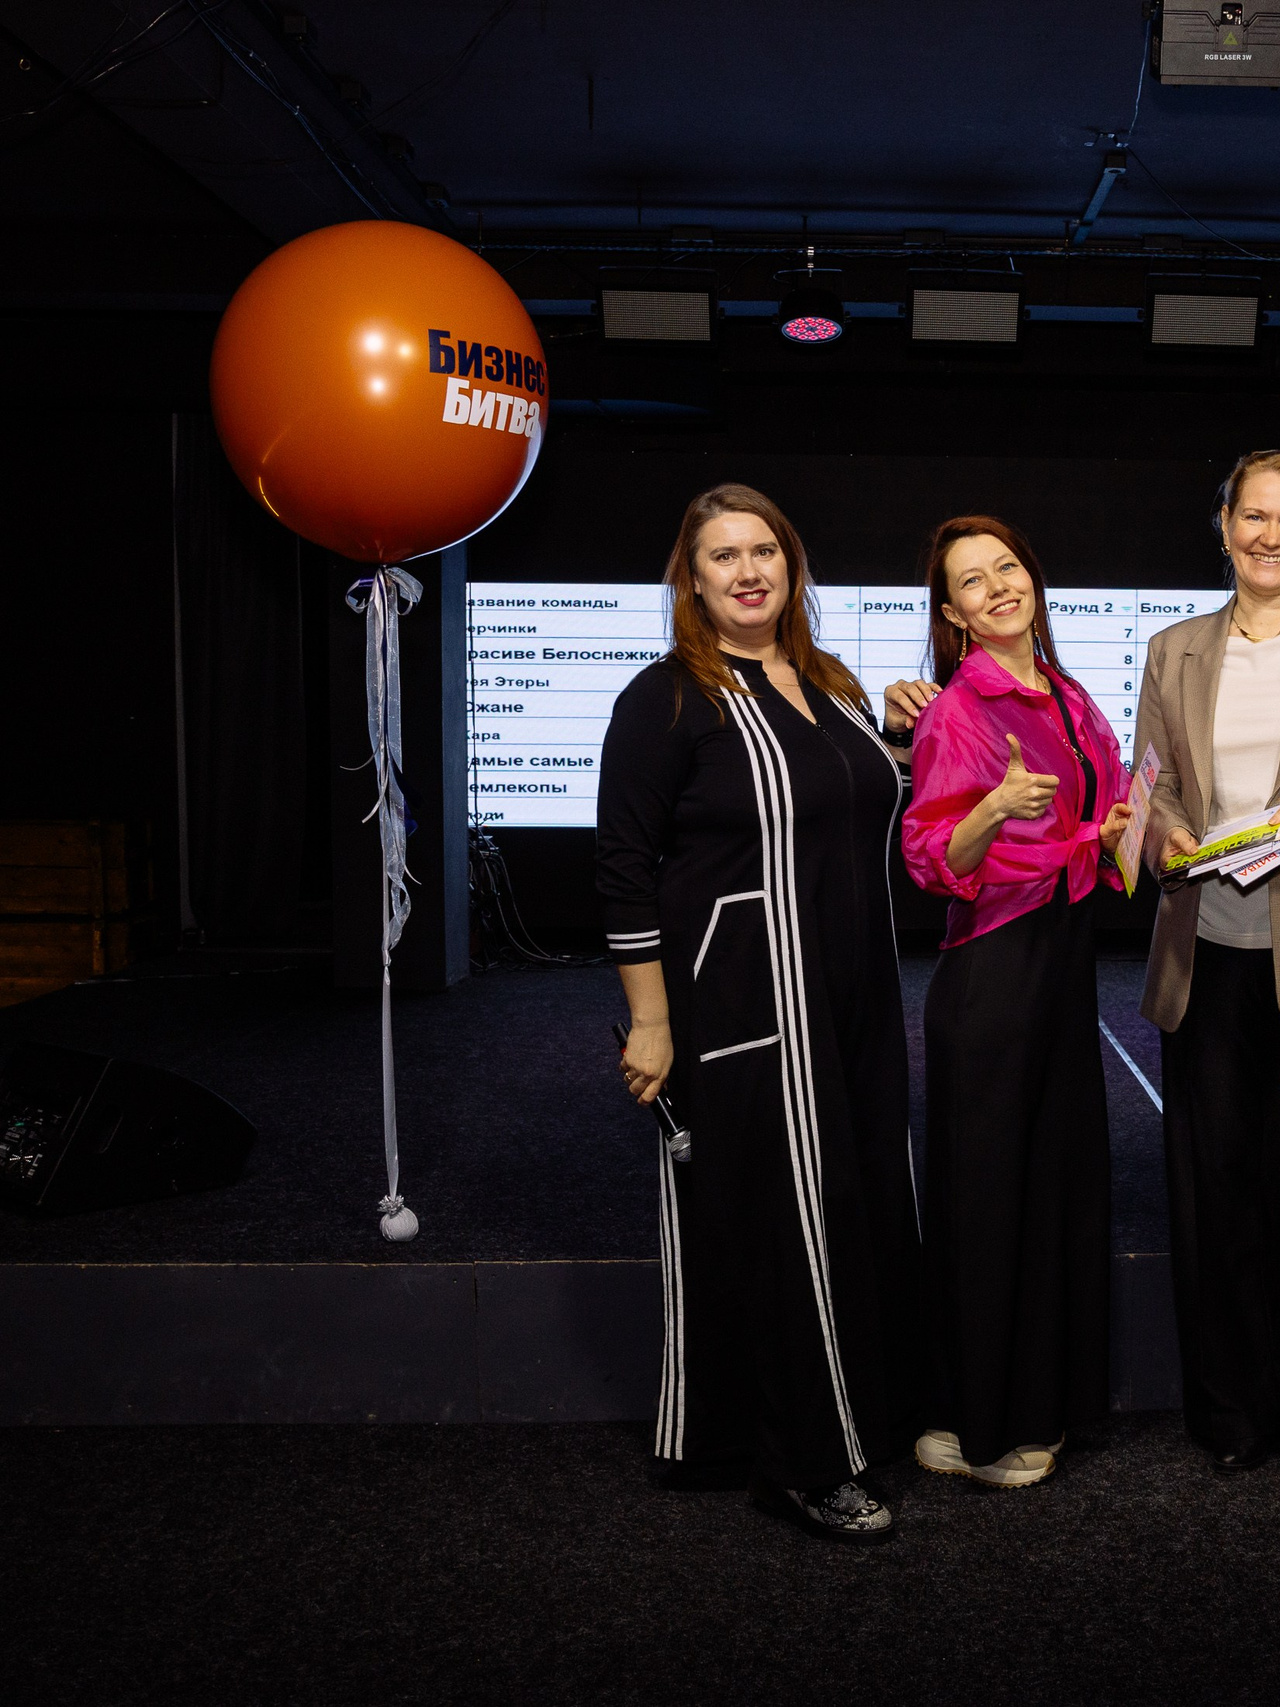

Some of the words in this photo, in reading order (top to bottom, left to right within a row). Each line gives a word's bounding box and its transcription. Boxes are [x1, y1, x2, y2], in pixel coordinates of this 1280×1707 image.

[428, 329, 545, 396] Бизнес
[442, 376, 541, 438] Битва
[467, 599, 536, 607] азвание
[542, 599, 618, 609] команды
[864, 602, 914, 613] раунд
[919, 601, 927, 610] 1
[1049, 602, 1099, 614] Раунд
[1104, 603, 1113, 613] 2
[1140, 603, 1181, 613] Блок
[1186, 603, 1195, 613] 2
[467, 625, 537, 635] ерчинки
[1124, 628, 1133, 638] 7
[467, 650, 536, 661] расиве
[542, 648, 660, 661] Белоснежки
[1124, 655, 1133, 664] 8
[495, 676, 549, 689] Этеры
[1124, 681, 1132, 691] 6
[1124, 707, 1132, 717] 9
[1124, 734, 1132, 743] 7
[468, 757, 524, 766] амые
[529, 757, 594, 767] самые
[468, 784, 567, 793] емлекопы
